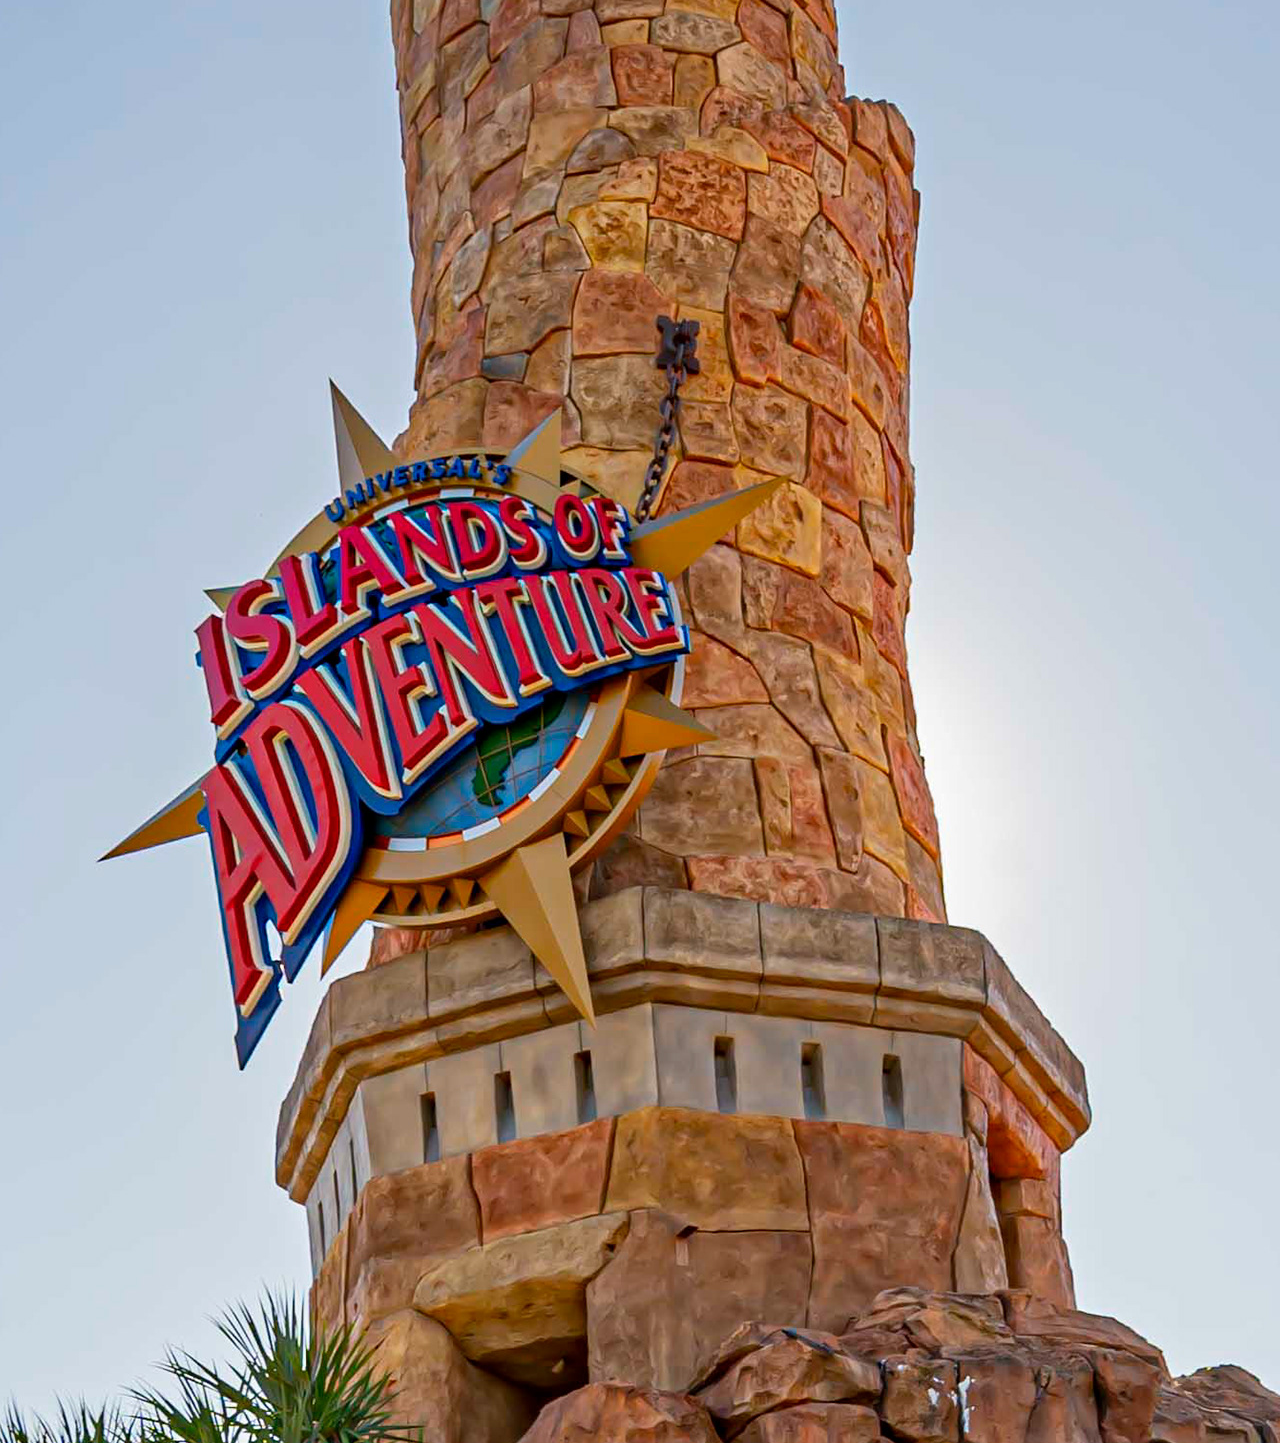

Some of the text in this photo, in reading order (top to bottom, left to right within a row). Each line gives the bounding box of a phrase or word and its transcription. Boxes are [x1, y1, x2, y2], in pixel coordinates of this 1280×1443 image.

[323, 456, 512, 523] UNIVERSAL'S
[195, 493, 629, 740] ISLANDS OF
[201, 567, 684, 1017] ADVENTURE
